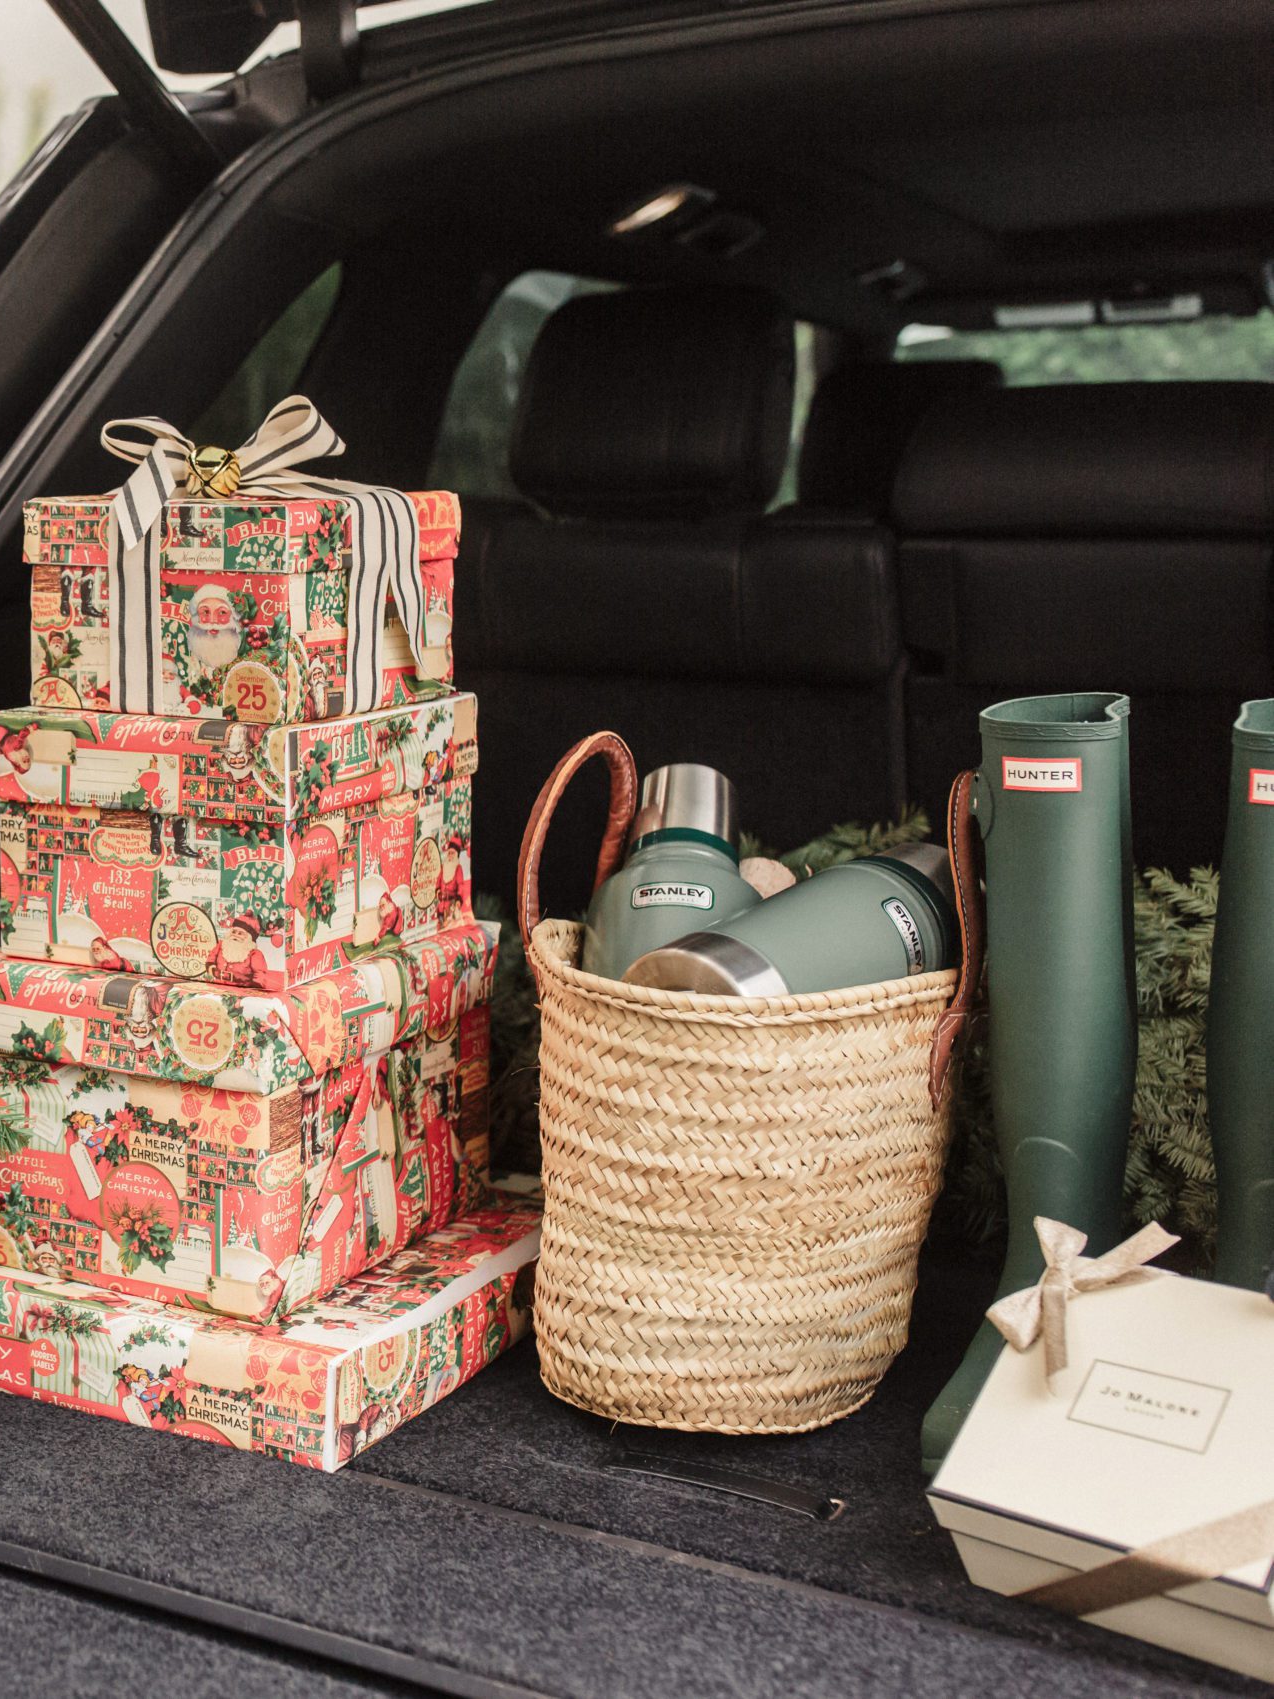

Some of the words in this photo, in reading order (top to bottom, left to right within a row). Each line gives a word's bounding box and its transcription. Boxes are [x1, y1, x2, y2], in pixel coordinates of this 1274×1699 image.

[241, 579, 253, 593] A
[235, 673, 267, 684] December
[237, 682, 267, 711] 25
[113, 720, 182, 748] Jingle
[331, 728, 371, 761] BELLS
[1007, 769, 1074, 781] HUNTER
[320, 783, 372, 811] MERRY
[311, 809, 344, 823] CHRISTMAS
[302, 836, 329, 850] MERRY
[381, 836, 411, 851] Christmas
[297, 846, 336, 864] CHRISTMAS
[388, 848, 405, 862] Seals
[92, 881, 146, 899] Christmas
[639, 886, 705, 898] STANLEY
[103, 897, 133, 910] Seals
[157, 922, 208, 944] JOYFUL
[893, 904, 922, 968] STANLEY
[295, 944, 331, 986] Jingle
[23, 979, 87, 1009] Jingle
[186, 1019, 220, 1050] 25
[133, 1136, 142, 1146] A
[145, 1137, 183, 1154] MERRY
[131, 1147, 185, 1168] CHRISTMAS
[0, 1167, 64, 1195] CHRISTMAS
[115, 1171, 160, 1186] MERRY
[107, 1181, 173, 1200] CHRISTMAS
[261, 1203, 299, 1226] Christmas
[273, 1220, 292, 1237] Seals
[40, 1342, 47, 1351] 6
[30, 1350, 57, 1362] ADDRESS
[33, 1359, 55, 1371] LABELS
[191, 1394, 200, 1406] A
[204, 1397, 247, 1417] MERRY
[188, 1406, 249, 1431] CHRISTMAS
